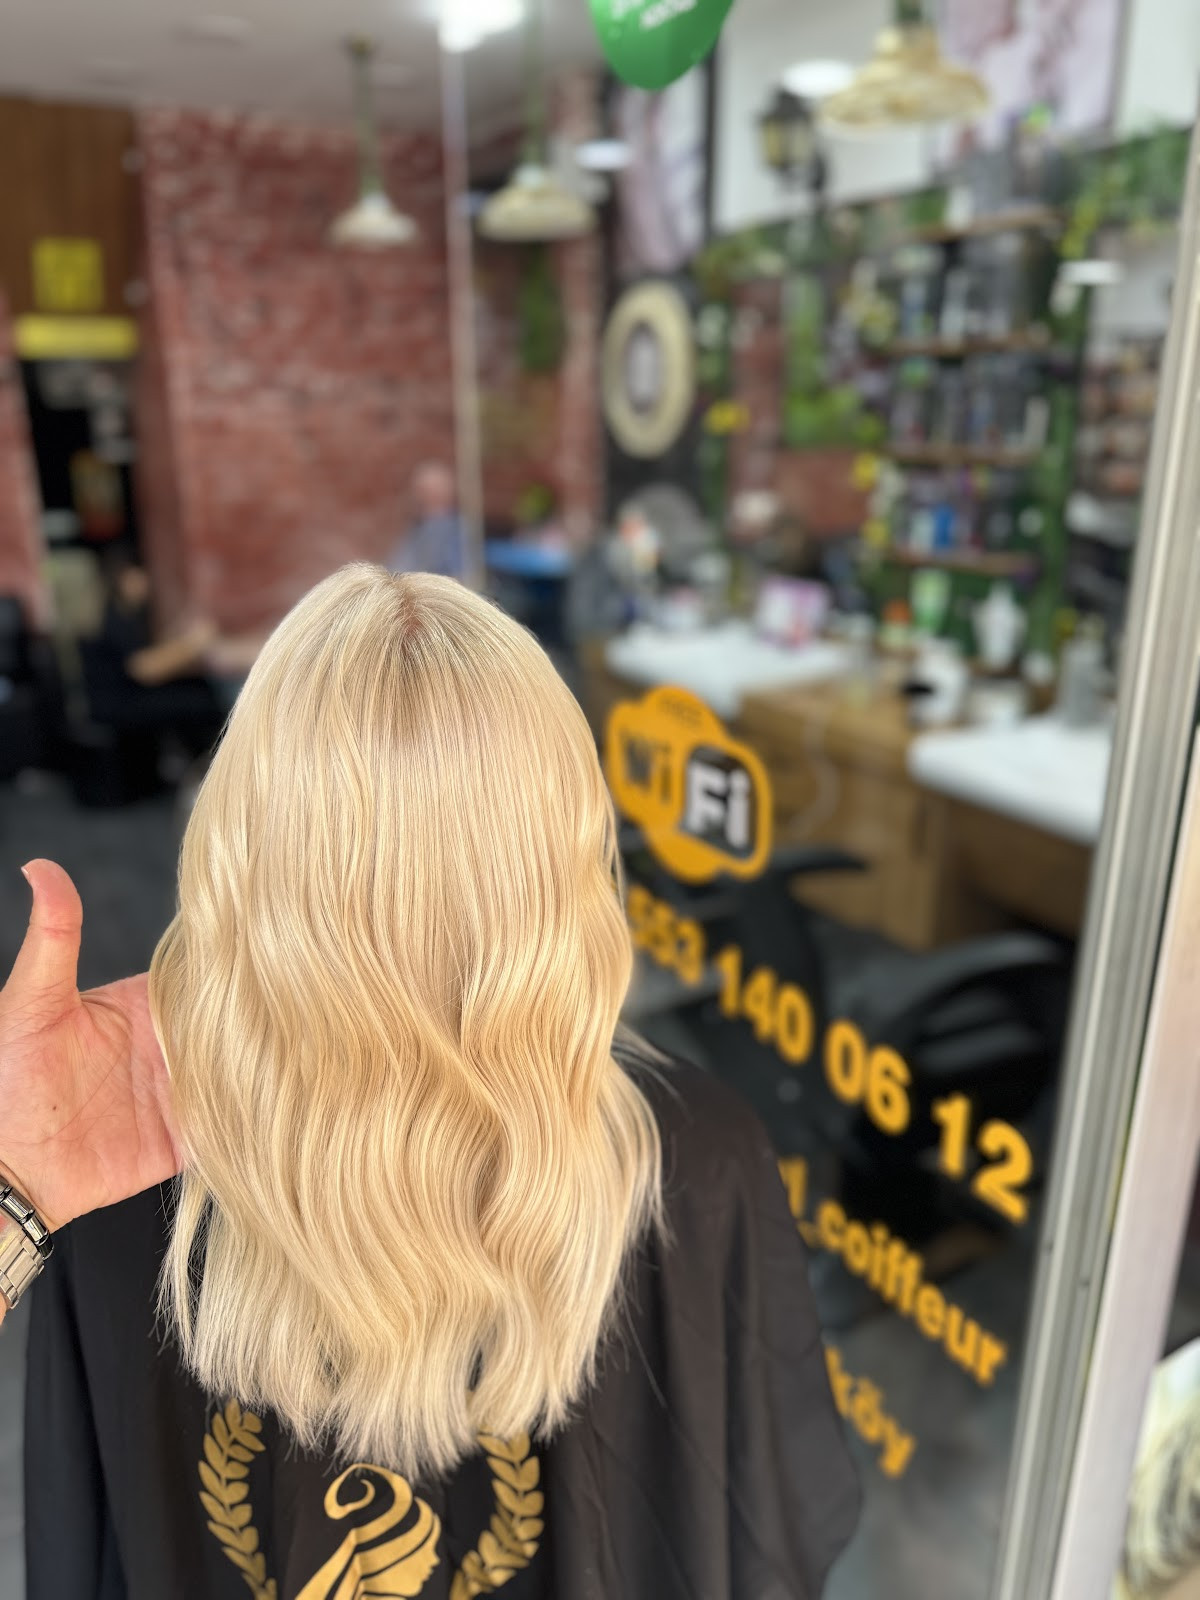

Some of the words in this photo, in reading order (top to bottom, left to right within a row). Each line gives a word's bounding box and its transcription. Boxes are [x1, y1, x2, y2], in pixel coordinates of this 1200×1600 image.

[714, 945, 814, 1064] 140
[824, 1020, 911, 1134] 06
[933, 1093, 1034, 1223] 12
